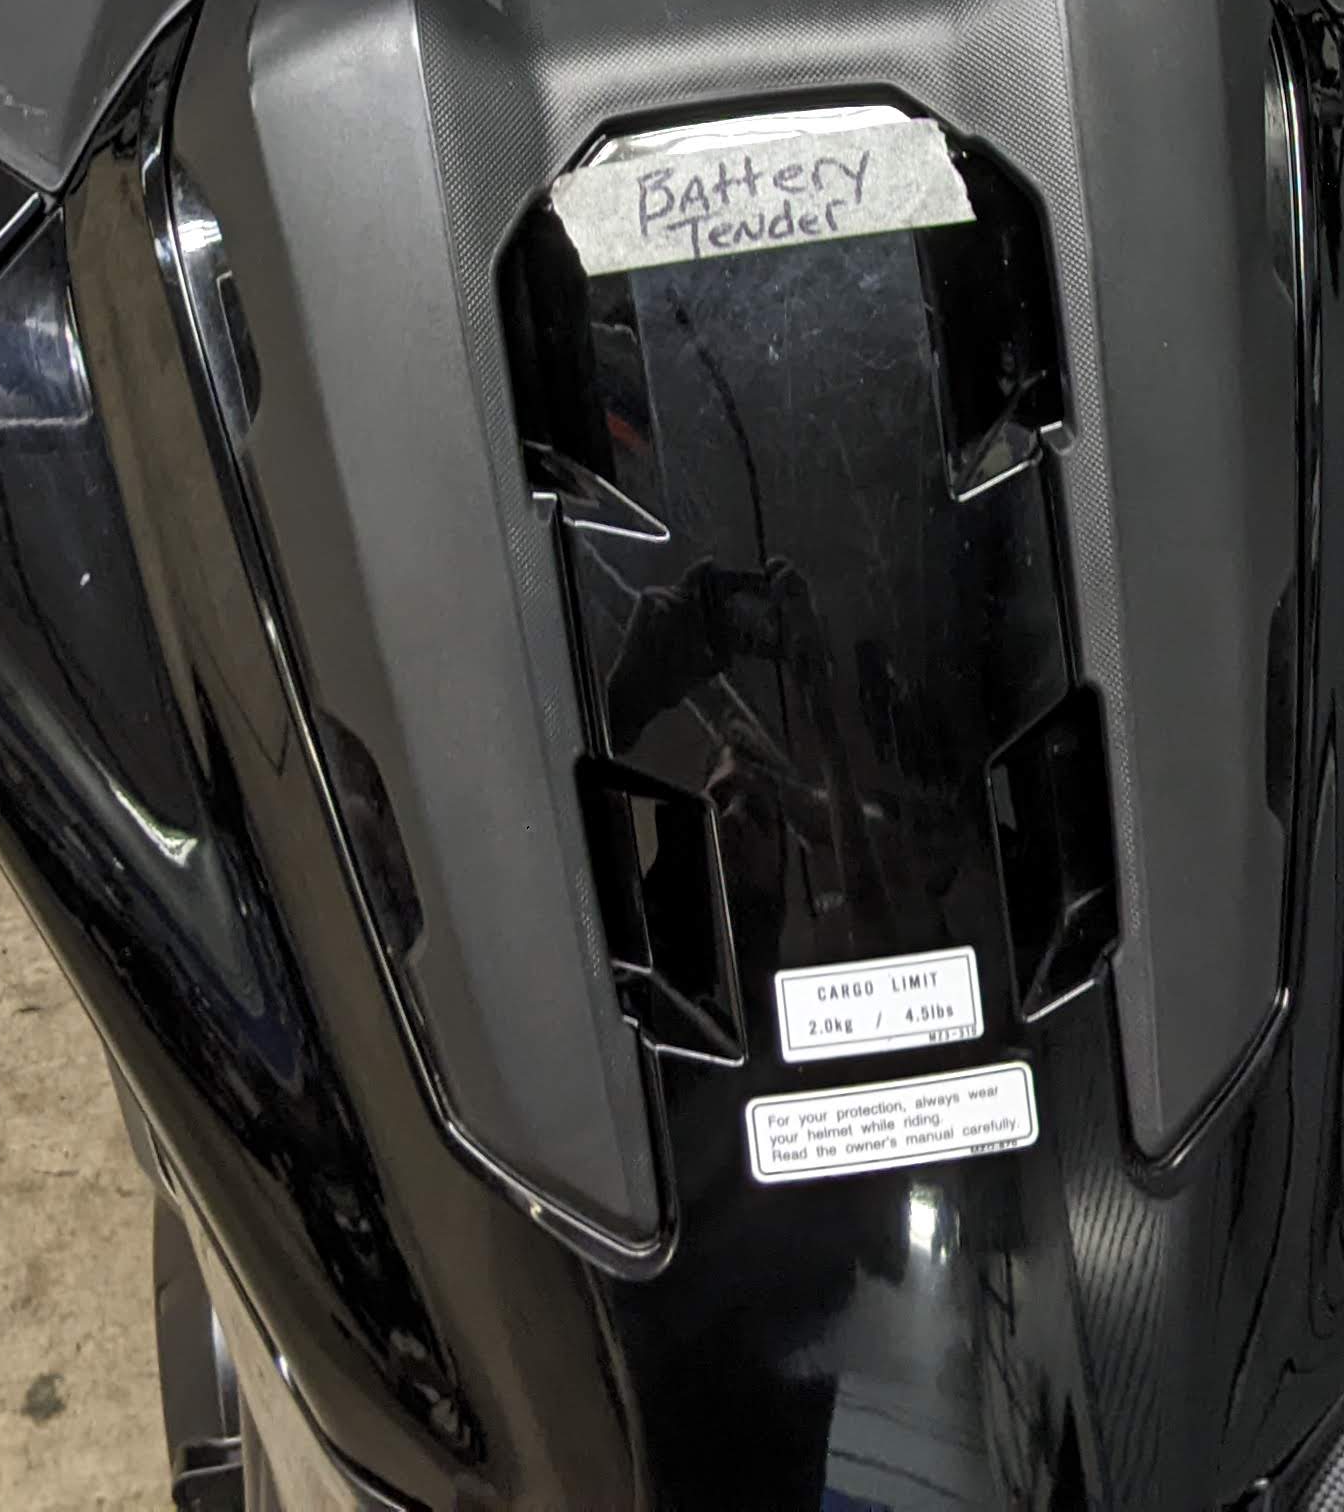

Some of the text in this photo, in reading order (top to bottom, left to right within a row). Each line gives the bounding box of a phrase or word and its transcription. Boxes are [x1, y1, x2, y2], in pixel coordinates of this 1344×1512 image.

[817, 972, 937, 1002] CARGO LIMIT
[808, 1017, 853, 1036] 2.0kg
[905, 1003, 955, 1024] 4.5lbs
[767, 1085, 998, 1129] For your protection, always wear
[769, 1112, 944, 1149] your helmet while riding.
[771, 1116, 1020, 1163] Read the owner's manual carefully.
